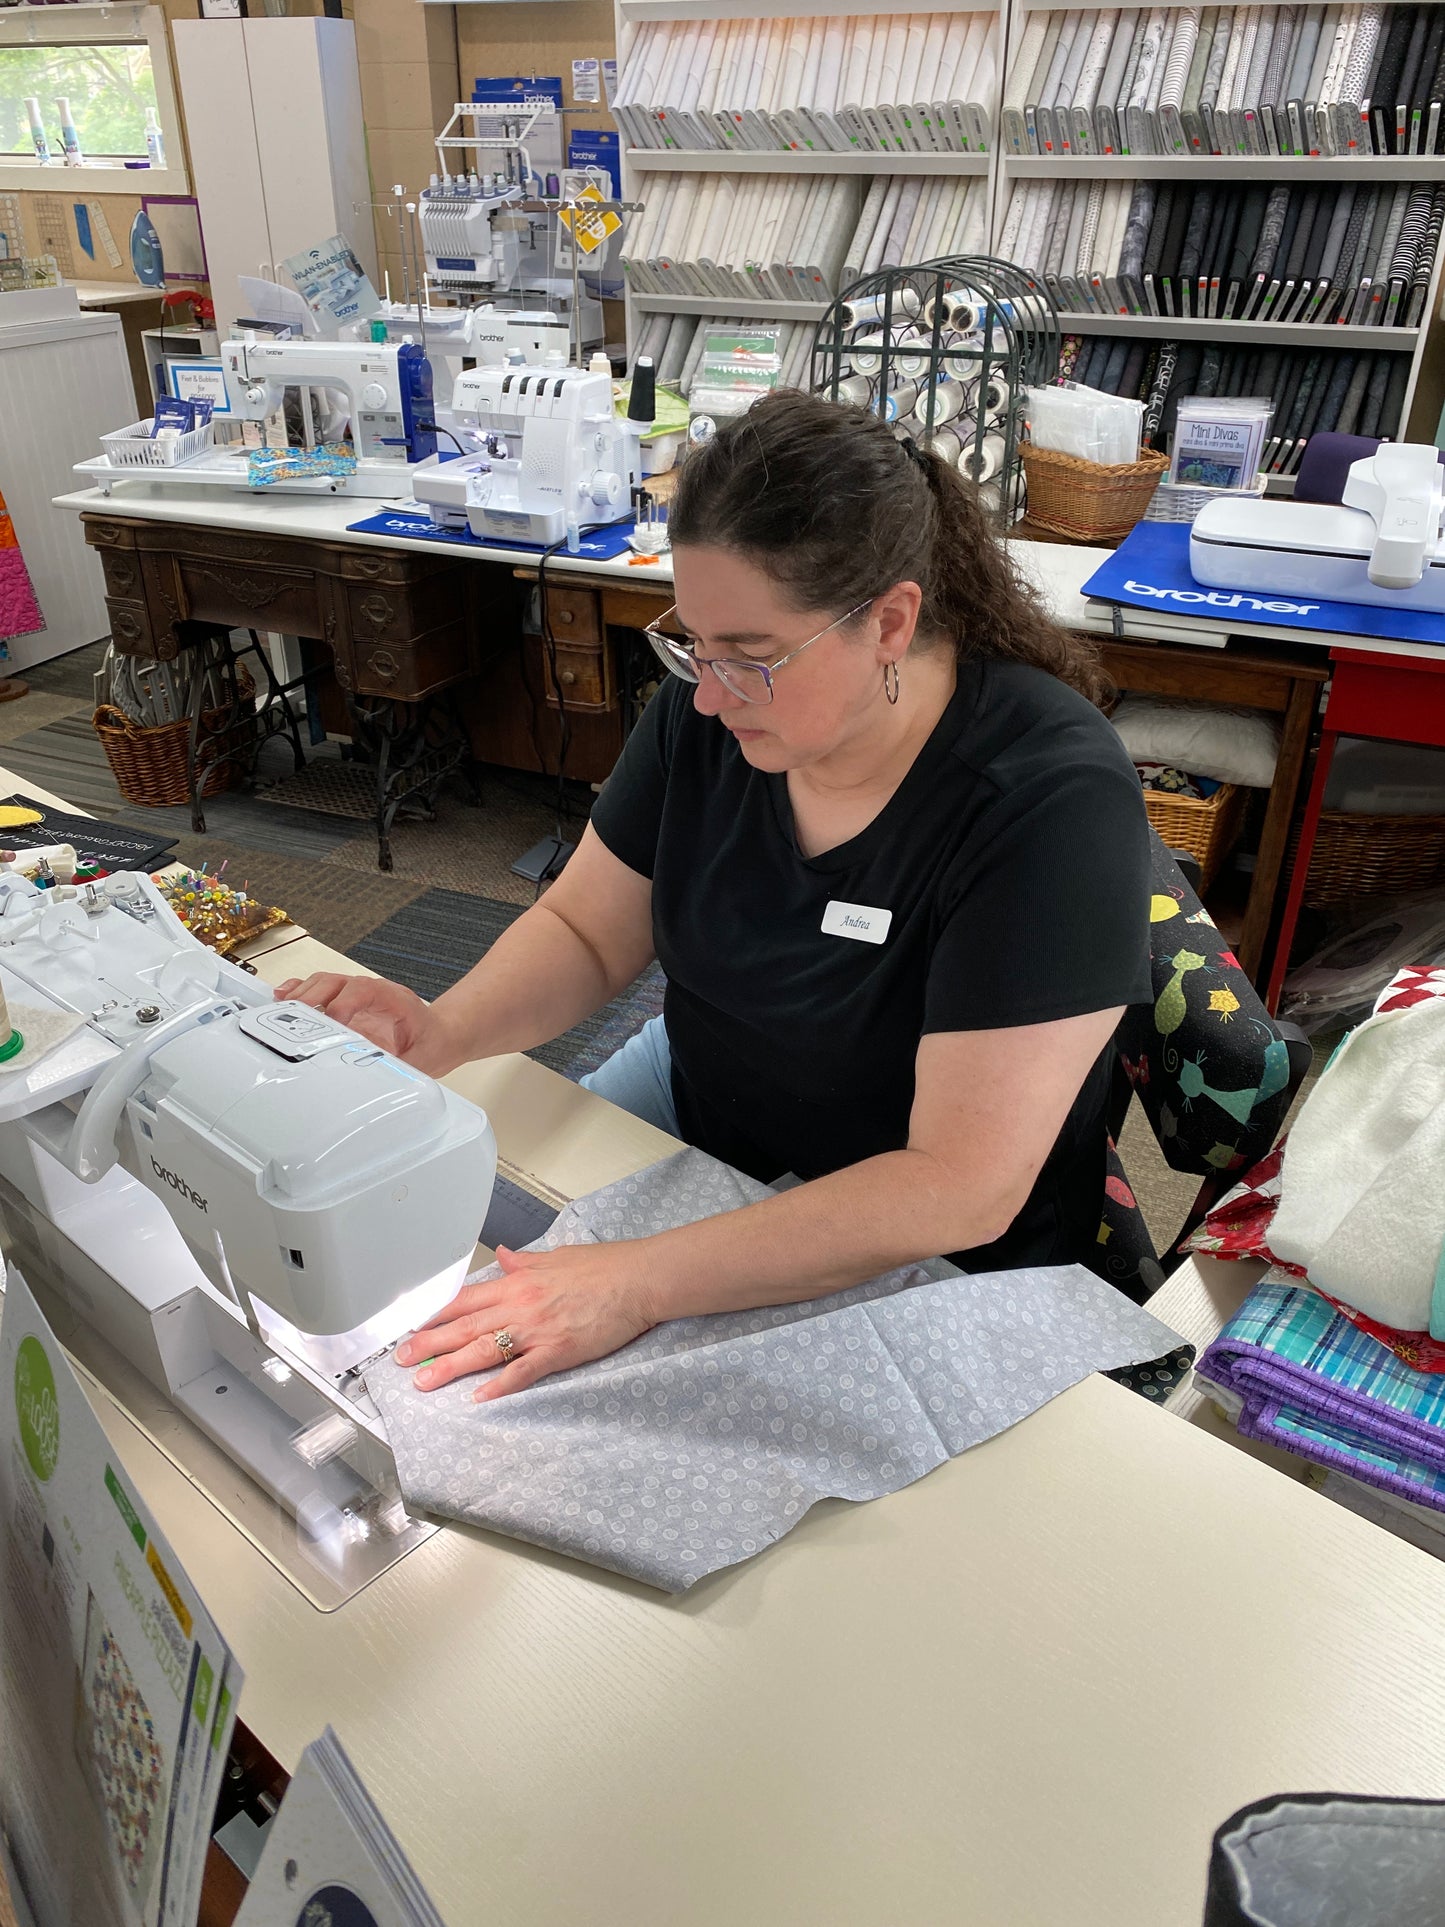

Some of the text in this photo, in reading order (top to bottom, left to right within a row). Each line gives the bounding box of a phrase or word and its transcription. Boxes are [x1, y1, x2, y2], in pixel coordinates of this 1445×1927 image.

[523, 93, 554, 103] brother
[571, 151, 597, 161] brother
[291, 249, 351, 281] WLAN-ENABLED
[334, 302, 359, 317] brother
[480, 334, 504, 342] brother
[1190, 424, 1240, 441] Mini Divas
[1123, 580, 1320, 615] brother
[840, 915, 871, 930] Andrea
[150, 1154, 209, 1214] brother
